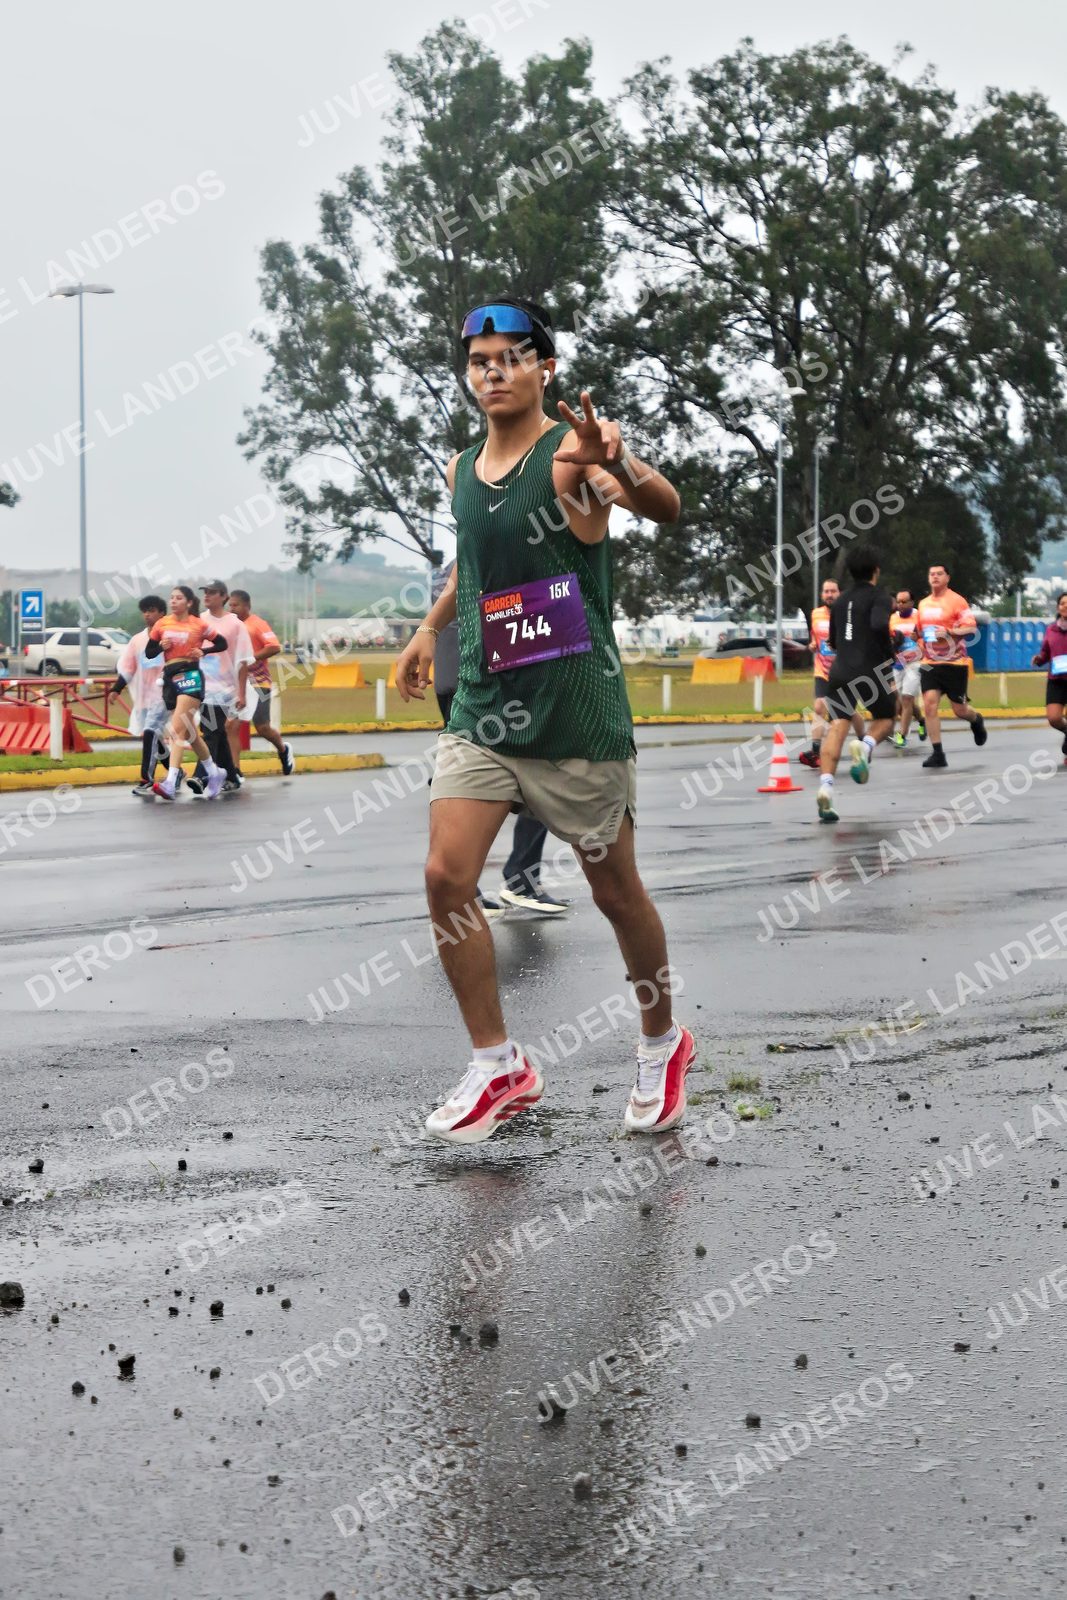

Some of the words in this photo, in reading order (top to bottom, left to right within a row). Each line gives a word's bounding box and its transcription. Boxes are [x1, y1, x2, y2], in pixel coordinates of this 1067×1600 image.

[549, 580, 570, 600] 15K
[484, 592, 522, 613] CARRERA
[505, 615, 552, 645] 744
